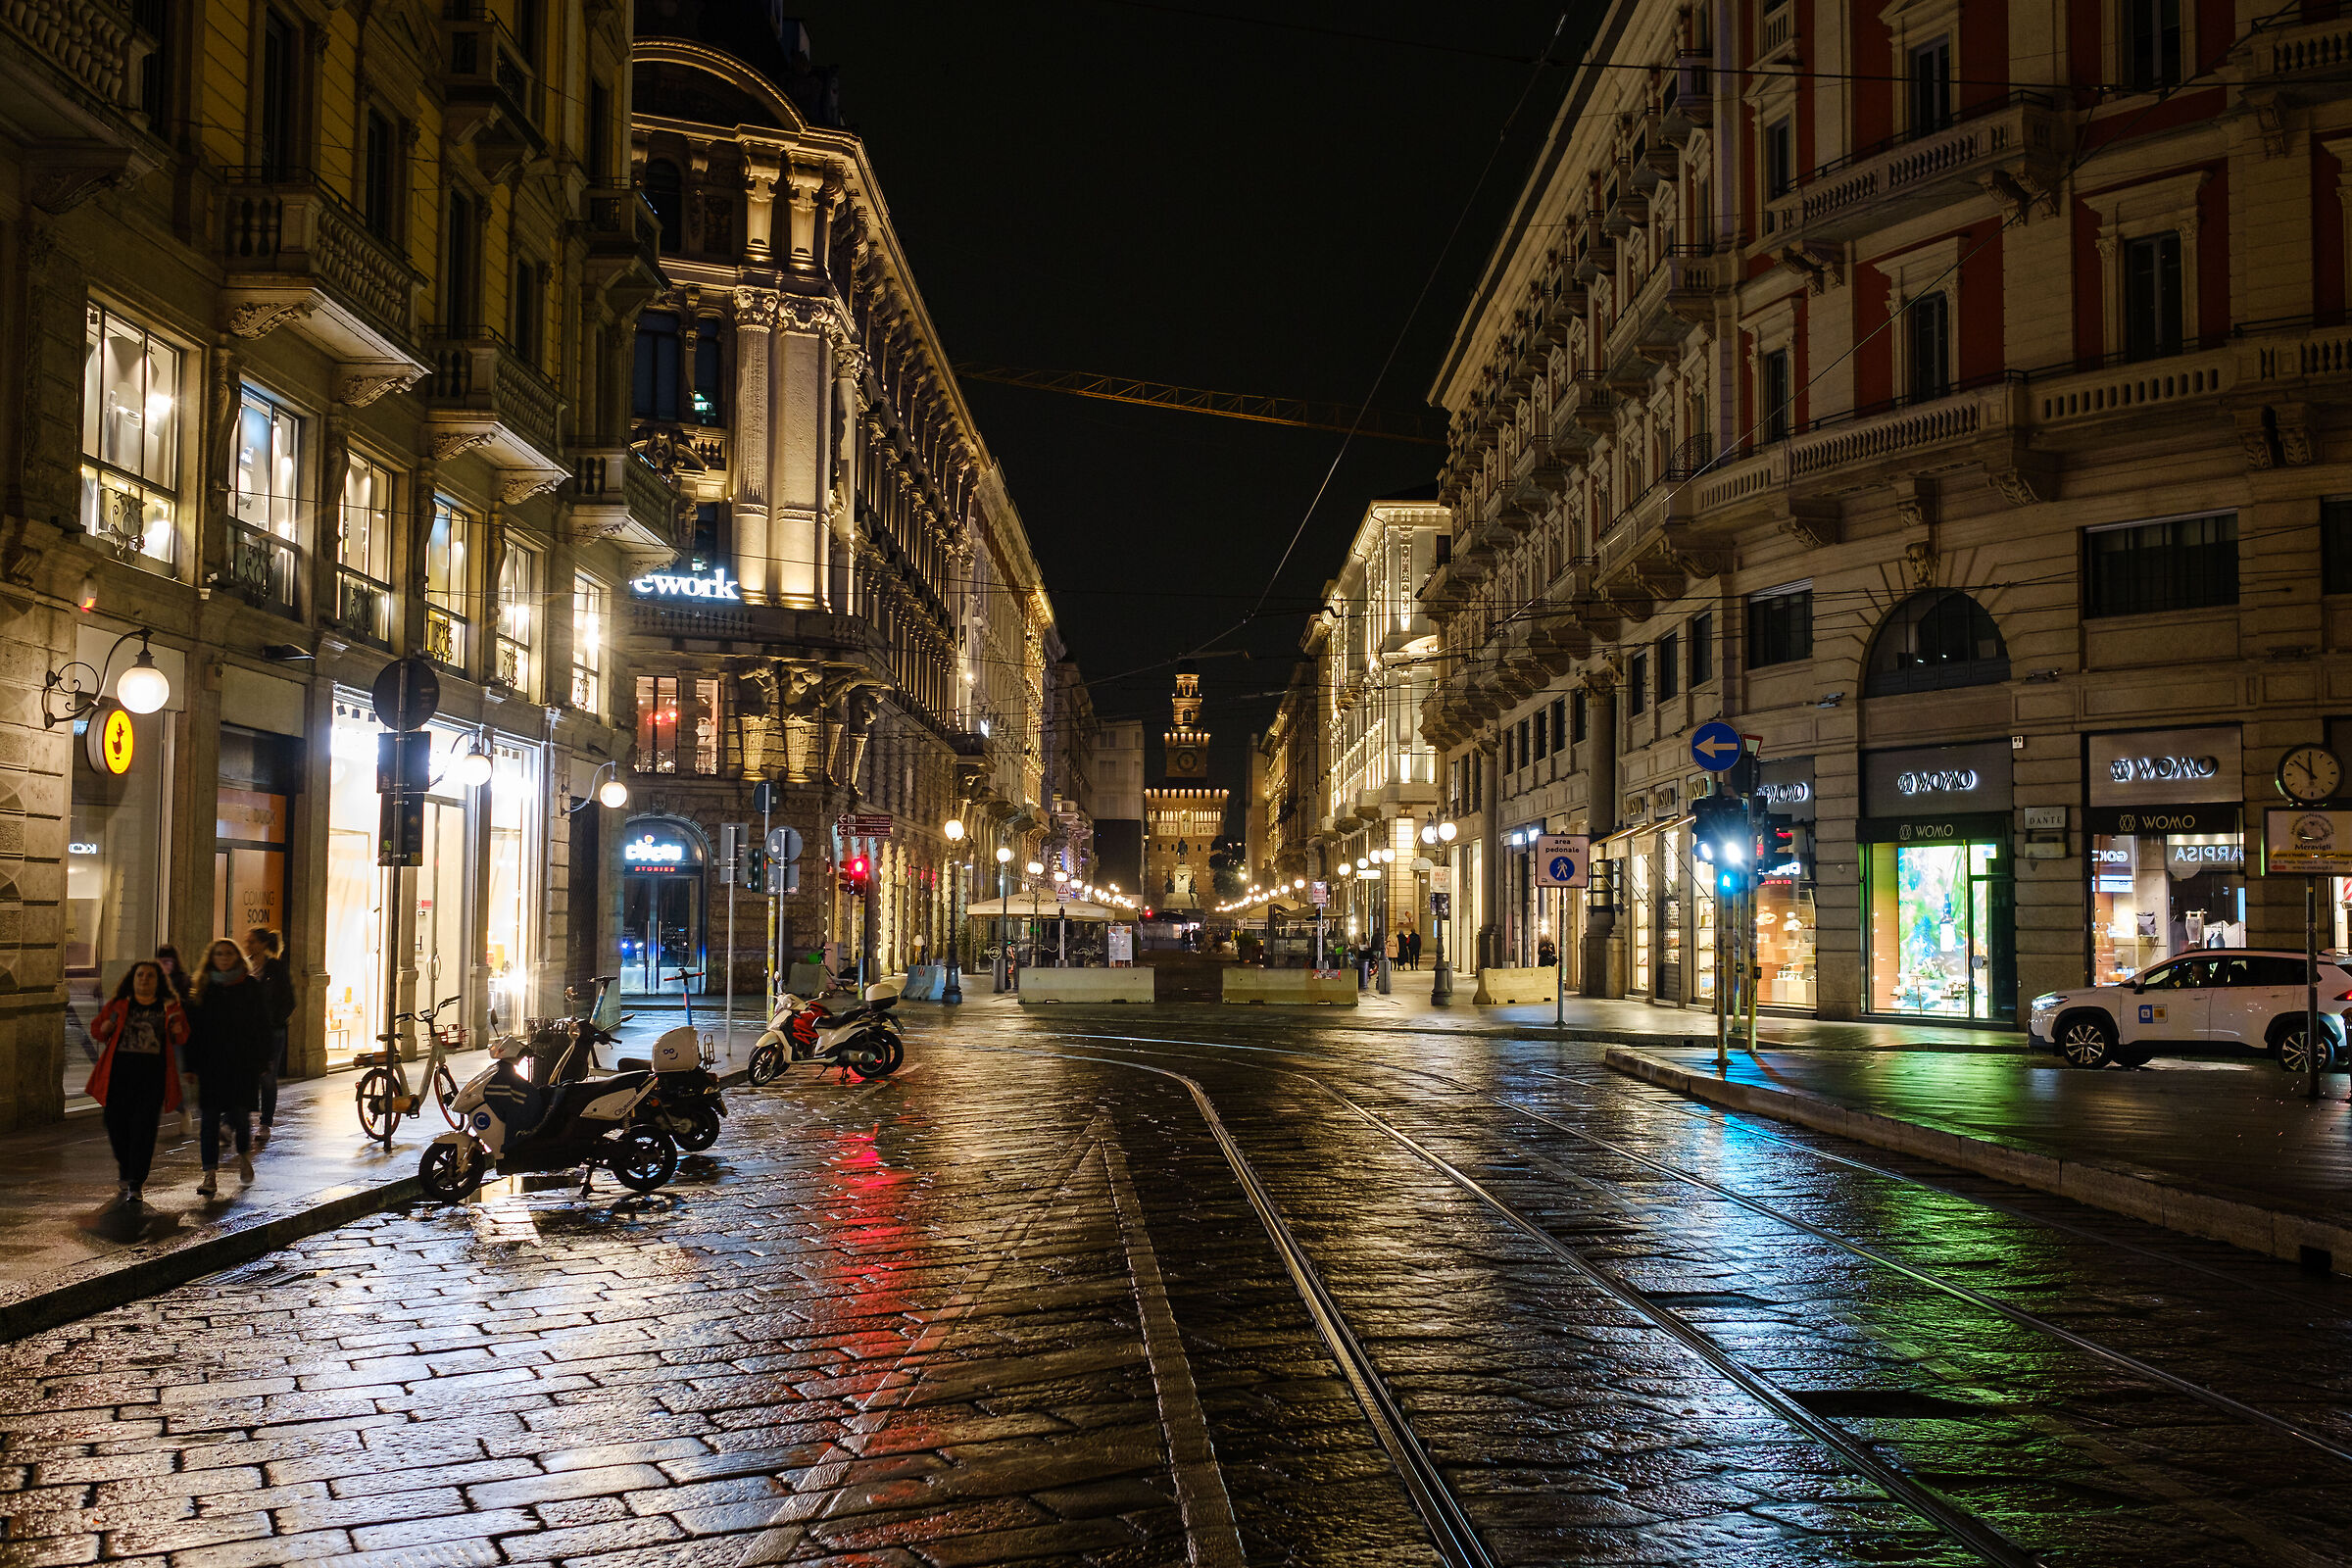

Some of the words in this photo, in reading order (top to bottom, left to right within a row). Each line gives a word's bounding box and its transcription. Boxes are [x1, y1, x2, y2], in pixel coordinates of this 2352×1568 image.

[628, 567, 740, 600] ework
[2134, 756, 2220, 779] WOMO
[1916, 769, 1976, 792] WOMO
[2030, 815, 2062, 825] DANTE
[2141, 814, 2196, 829] WOMO
[1916, 823, 1954, 838] WOMO
[243, 890, 274, 906] COMING
[247, 908, 270, 923] SOON
